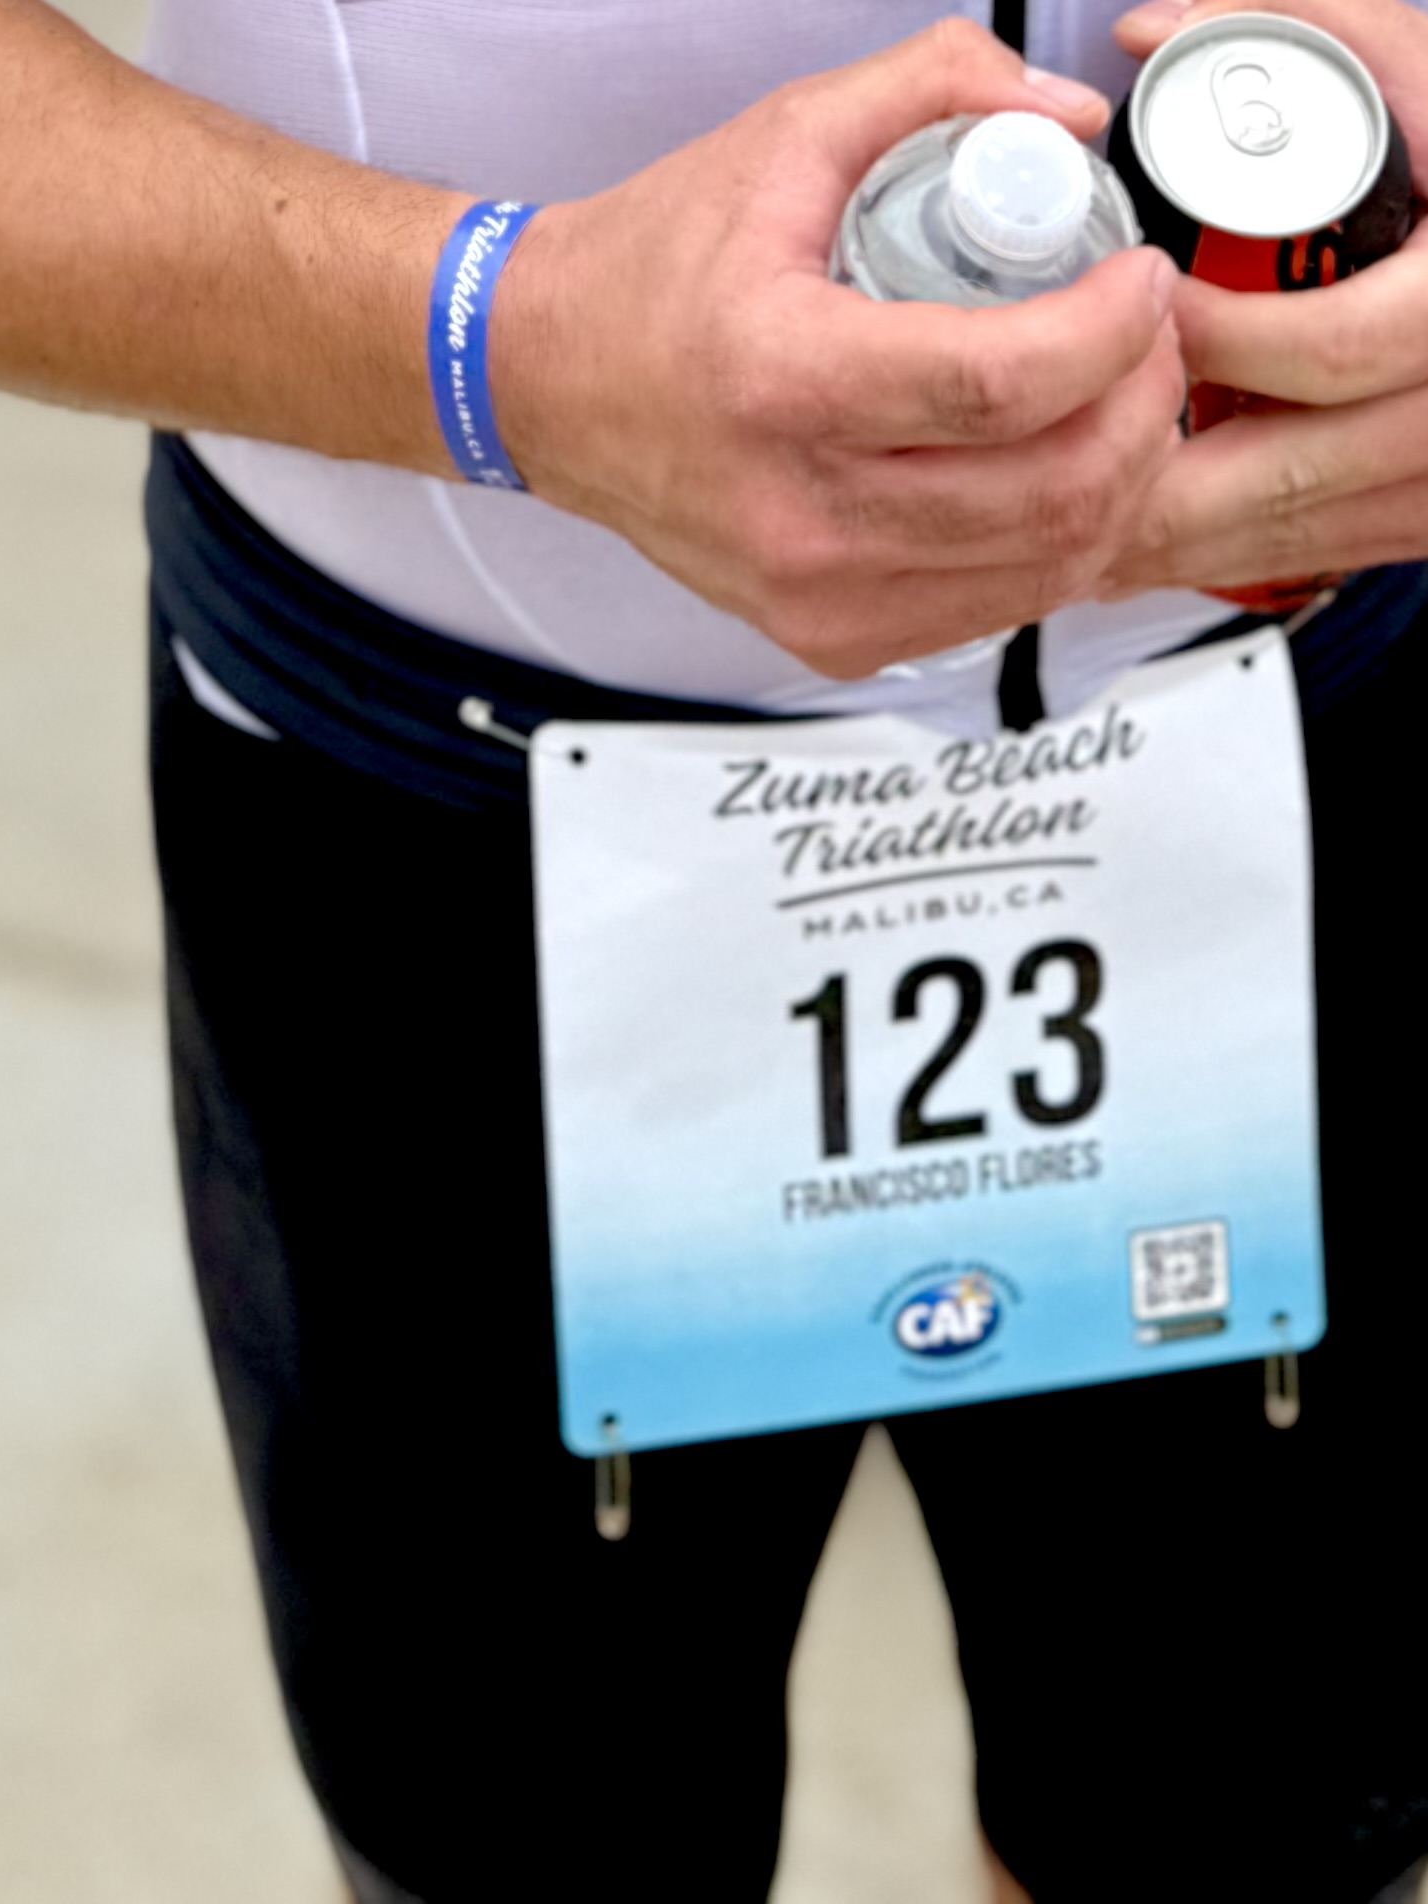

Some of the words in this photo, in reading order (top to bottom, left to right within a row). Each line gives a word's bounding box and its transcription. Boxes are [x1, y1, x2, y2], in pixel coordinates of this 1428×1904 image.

[448, 215, 508, 352] Triathlon
[713, 759, 924, 819] Zuma
[936, 703, 1146, 794] Beach
[774, 797, 1097, 877] Triathlon
[789, 936, 1107, 1160] 123
[782, 1158, 970, 1223] FRANCISCO
[978, 1139, 1103, 1193] FLORES
[896, 1297, 993, 1350] CAF
